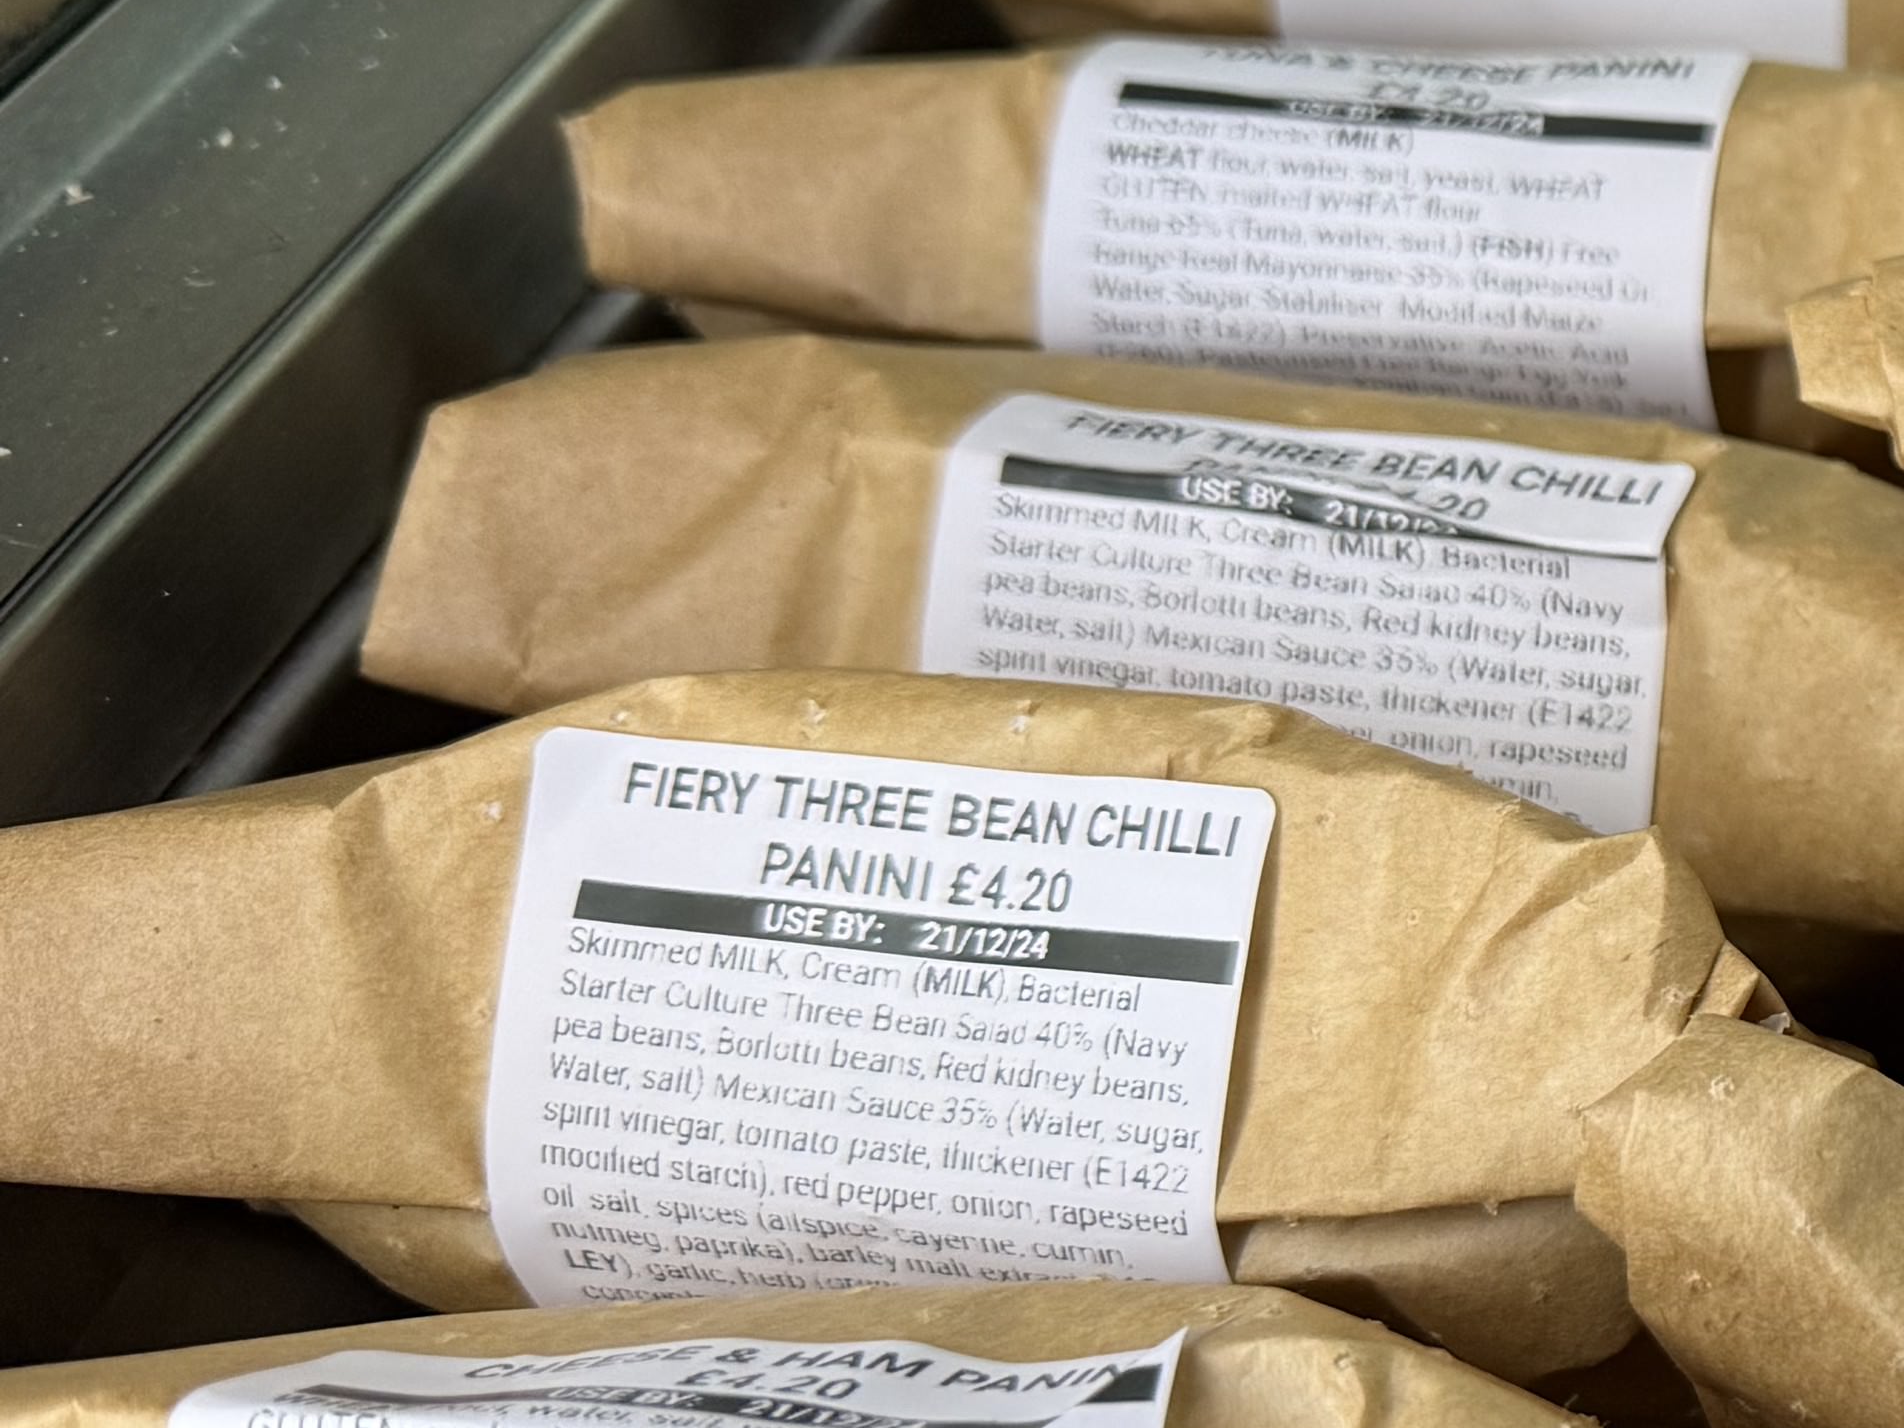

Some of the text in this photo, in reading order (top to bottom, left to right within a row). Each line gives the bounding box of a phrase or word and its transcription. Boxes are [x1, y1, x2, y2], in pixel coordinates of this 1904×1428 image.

[1066, 413, 1197, 445] FIERY
[1210, 432, 1365, 470] THREE
[1374, 450, 1499, 486] BEAN
[1510, 464, 1663, 505] CHILLI
[1180, 476, 1240, 506] USE
[1248, 483, 1293, 517] BY:
[624, 762, 1240, 856] FIERY THREE BEAN CHILLI
[760, 844, 1072, 913] PANINI £4.20
[568, 927, 702, 966] Skimmed
[801, 953, 901, 987] Cream
[1017, 973, 1141, 1012] Bacterial
[761, 905, 1050, 960] USE BY: 21/12/24
[560, 968, 1188, 1066] Starter Culture Three Bean Salad 40% (Navy
[552, 1016, 603, 1044] pea
[610, 1019, 706, 1055] beans,
[933, 1051, 989, 1084] Red
[992, 1058, 1086, 1098] kidney
[1091, 1067, 1188, 1106] beans,
[464, 1345, 713, 1380] CHEESE
[716, 1346, 755, 1365] &
[766, 1350, 936, 1380] HAM
[675, 1370, 861, 1401] £4.20
